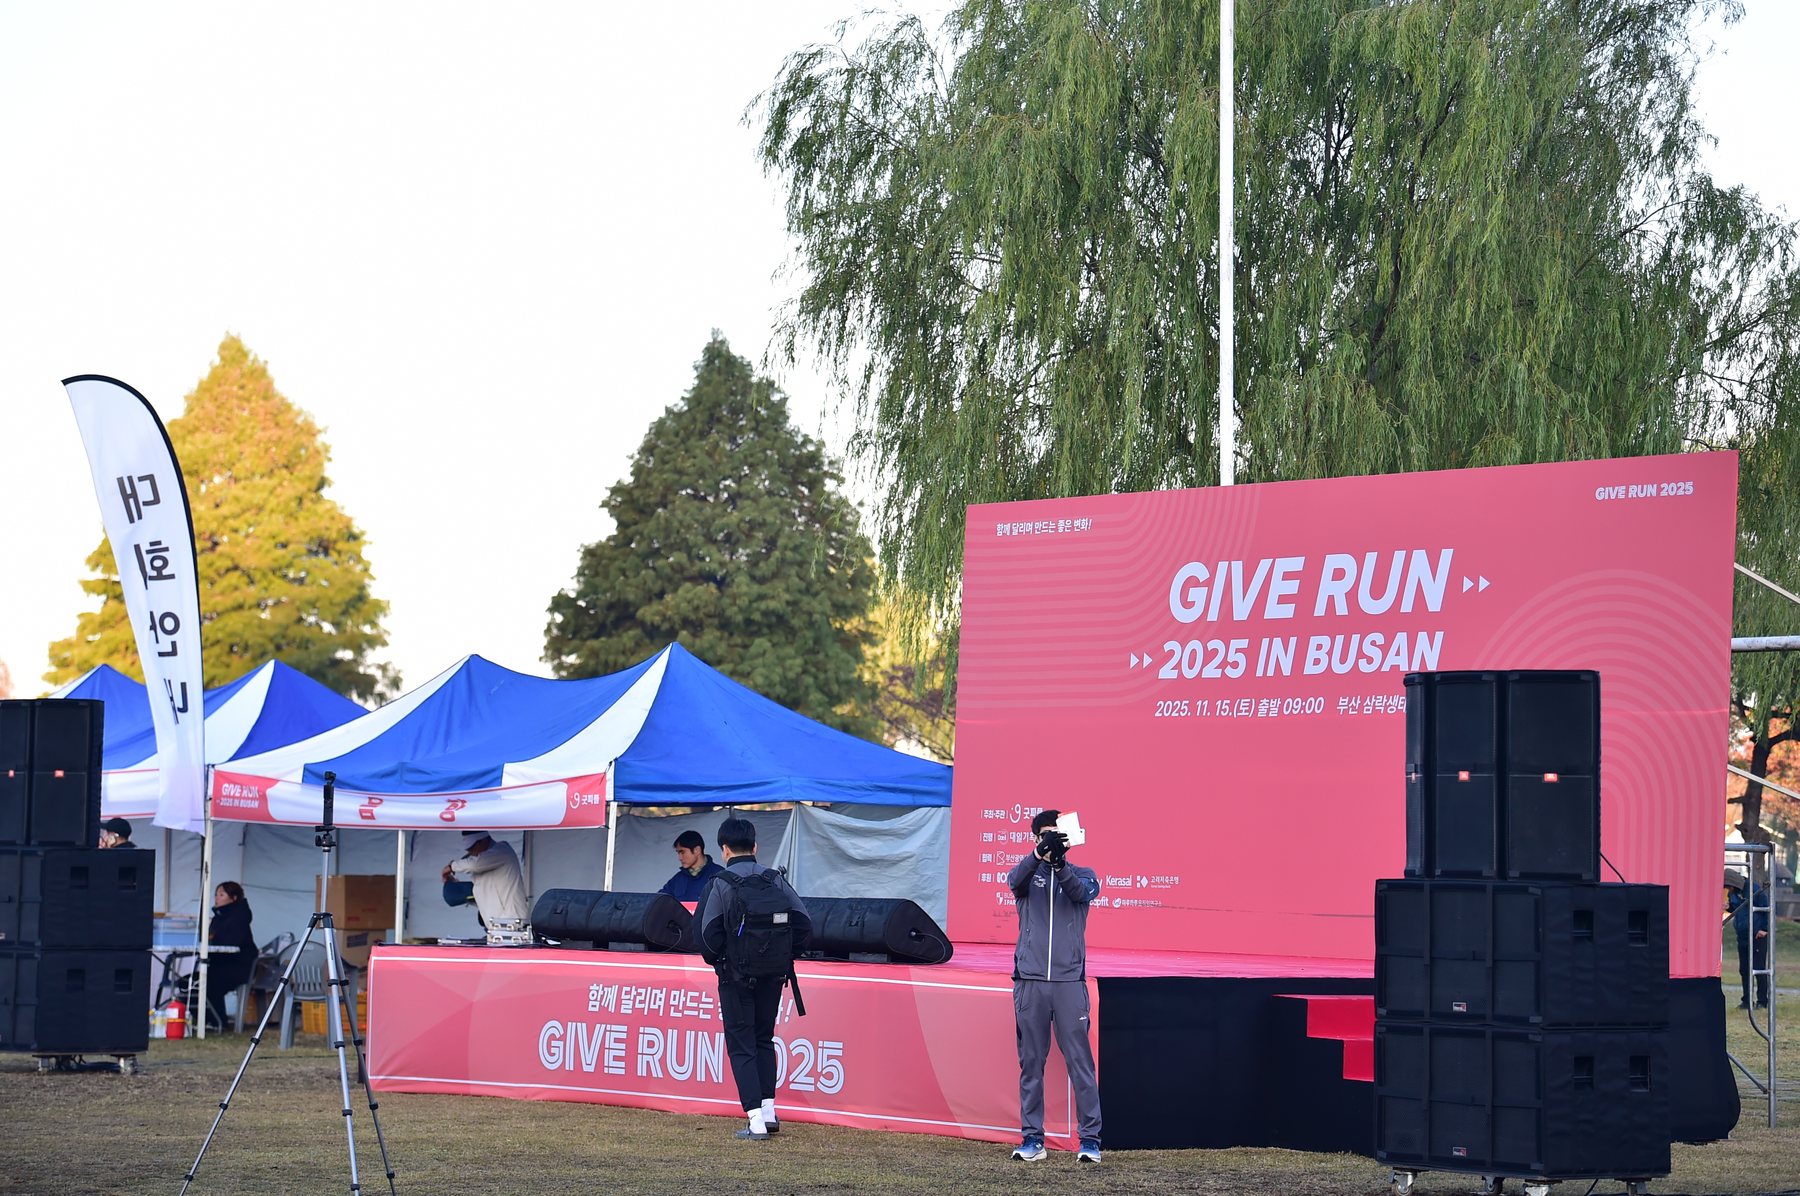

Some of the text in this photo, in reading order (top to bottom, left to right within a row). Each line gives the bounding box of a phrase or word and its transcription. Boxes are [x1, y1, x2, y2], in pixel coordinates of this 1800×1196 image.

[1595, 481, 1694, 500] GIVE RUN 2025
[996, 522, 1011, 537] 함께
[1011, 521, 1034, 536] 달리며
[1034, 520, 1056, 535] 만드는
[1057, 519, 1072, 533] 좋은
[1168, 548, 1454, 624] GIVE RUN
[1157, 630, 1445, 680] 2025 IN BUSAN
[1154, 700, 1191, 717] 2025.
[1196, 699, 1211, 717] 11.
[1257, 697, 1282, 717] 출발
[1283, 696, 1325, 716] 09:00
[1336, 695, 1362, 715] 부산
[221, 782, 242, 798] GIVE
[239, 798, 260, 809] BUSAN
[1105, 874, 1132, 887] Kerasal
[587, 983, 619, 1014] 함께
[620, 985, 667, 1017] 달리며
[669, 988, 715, 1020] 만드는
[538, 1019, 845, 1095] GIVE RUN 025
